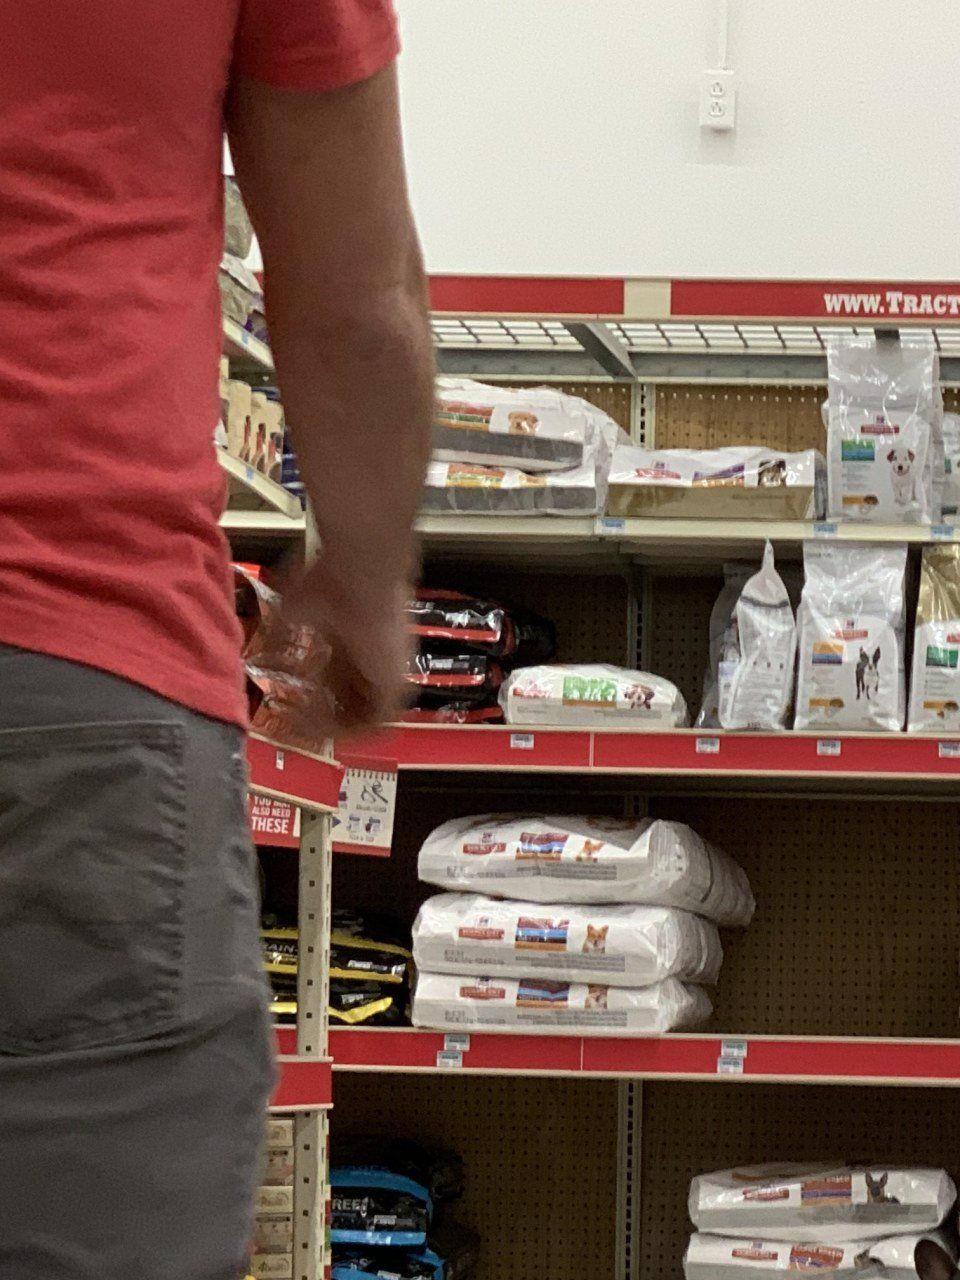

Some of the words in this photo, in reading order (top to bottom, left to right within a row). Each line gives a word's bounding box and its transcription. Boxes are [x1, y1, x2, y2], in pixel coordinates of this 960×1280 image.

[252, 806, 271, 816] ALSO
[272, 807, 290, 818] NEED
[251, 816, 290, 834] THESE
